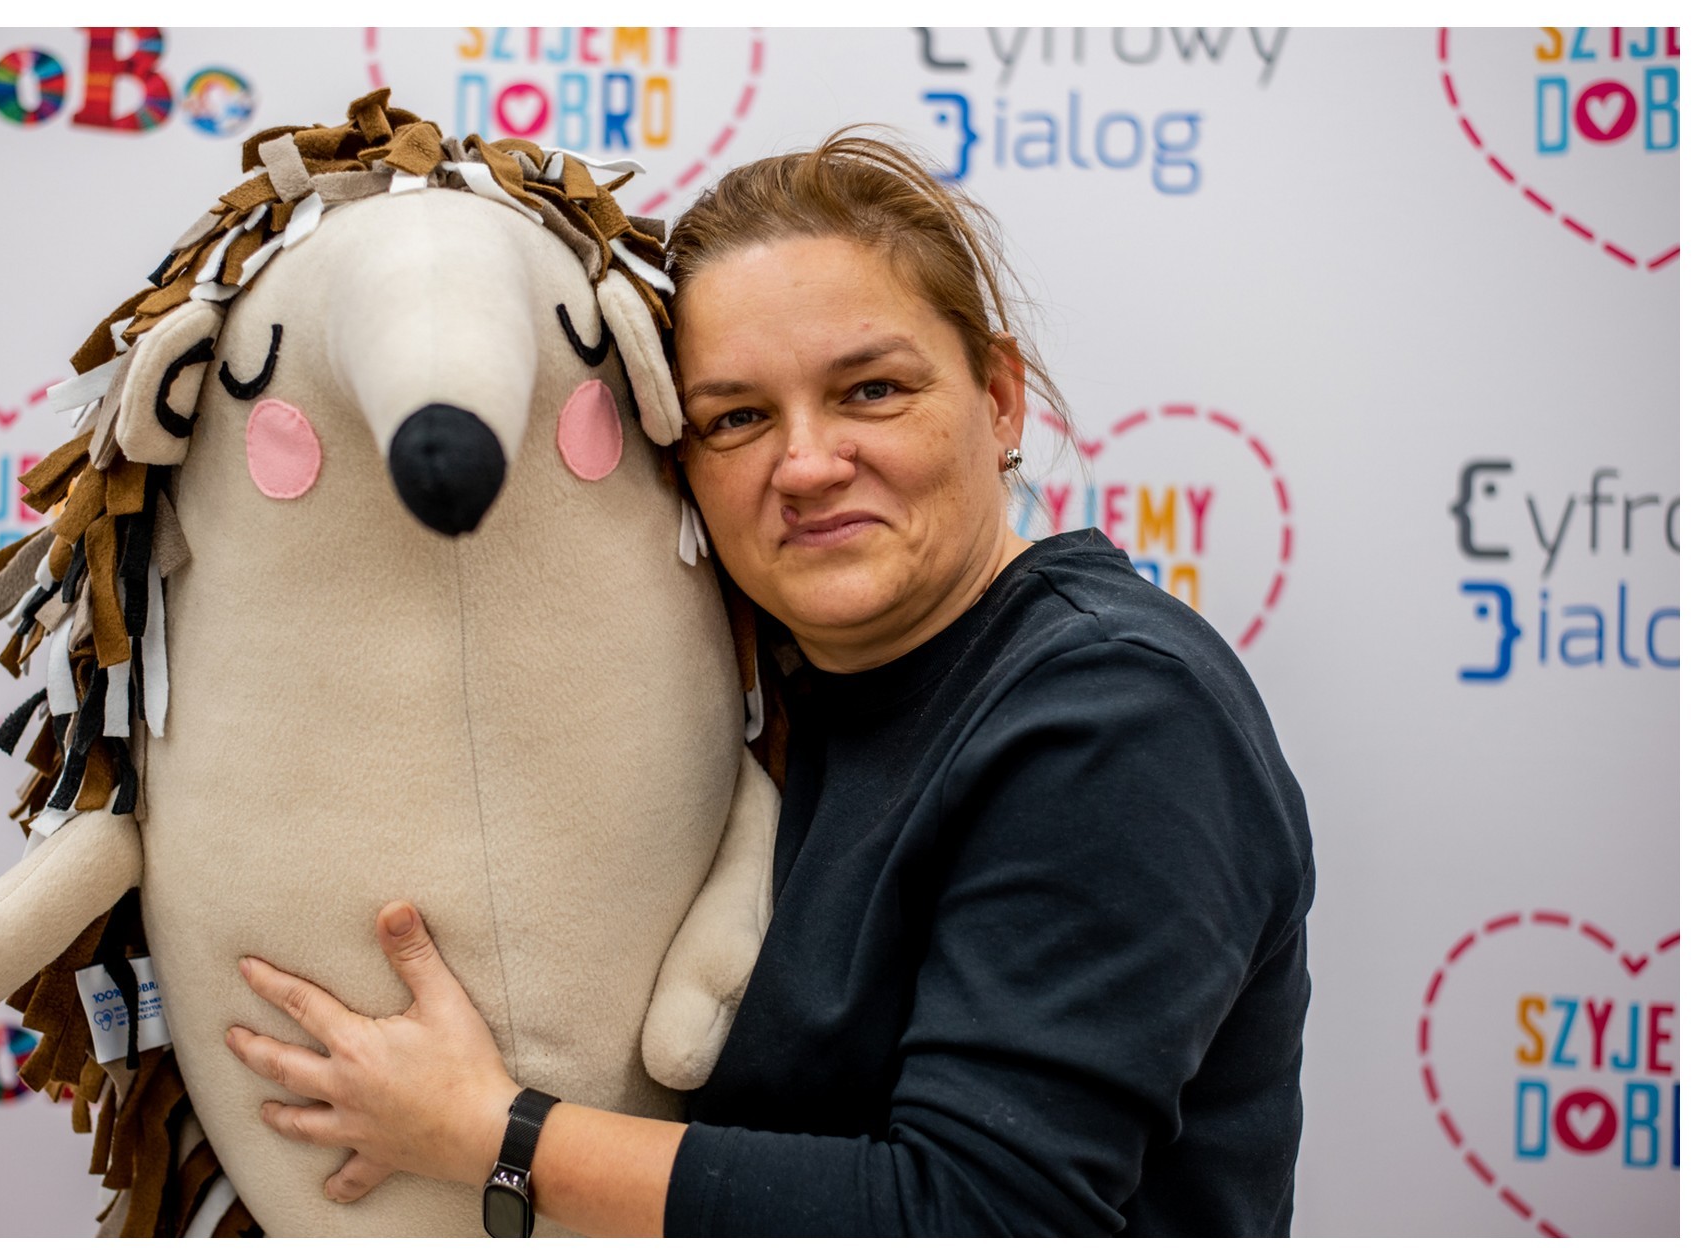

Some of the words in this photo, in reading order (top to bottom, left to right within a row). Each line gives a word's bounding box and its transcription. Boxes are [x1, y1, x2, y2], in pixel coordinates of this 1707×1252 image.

[456, 71, 675, 150] DOBRO
[919, 92, 1209, 196] Dialog
[1017, 485, 1216, 557] ZYJEMY
[1515, 995, 1676, 1077] SZYJE
[1515, 1078, 1680, 1171] DOB
